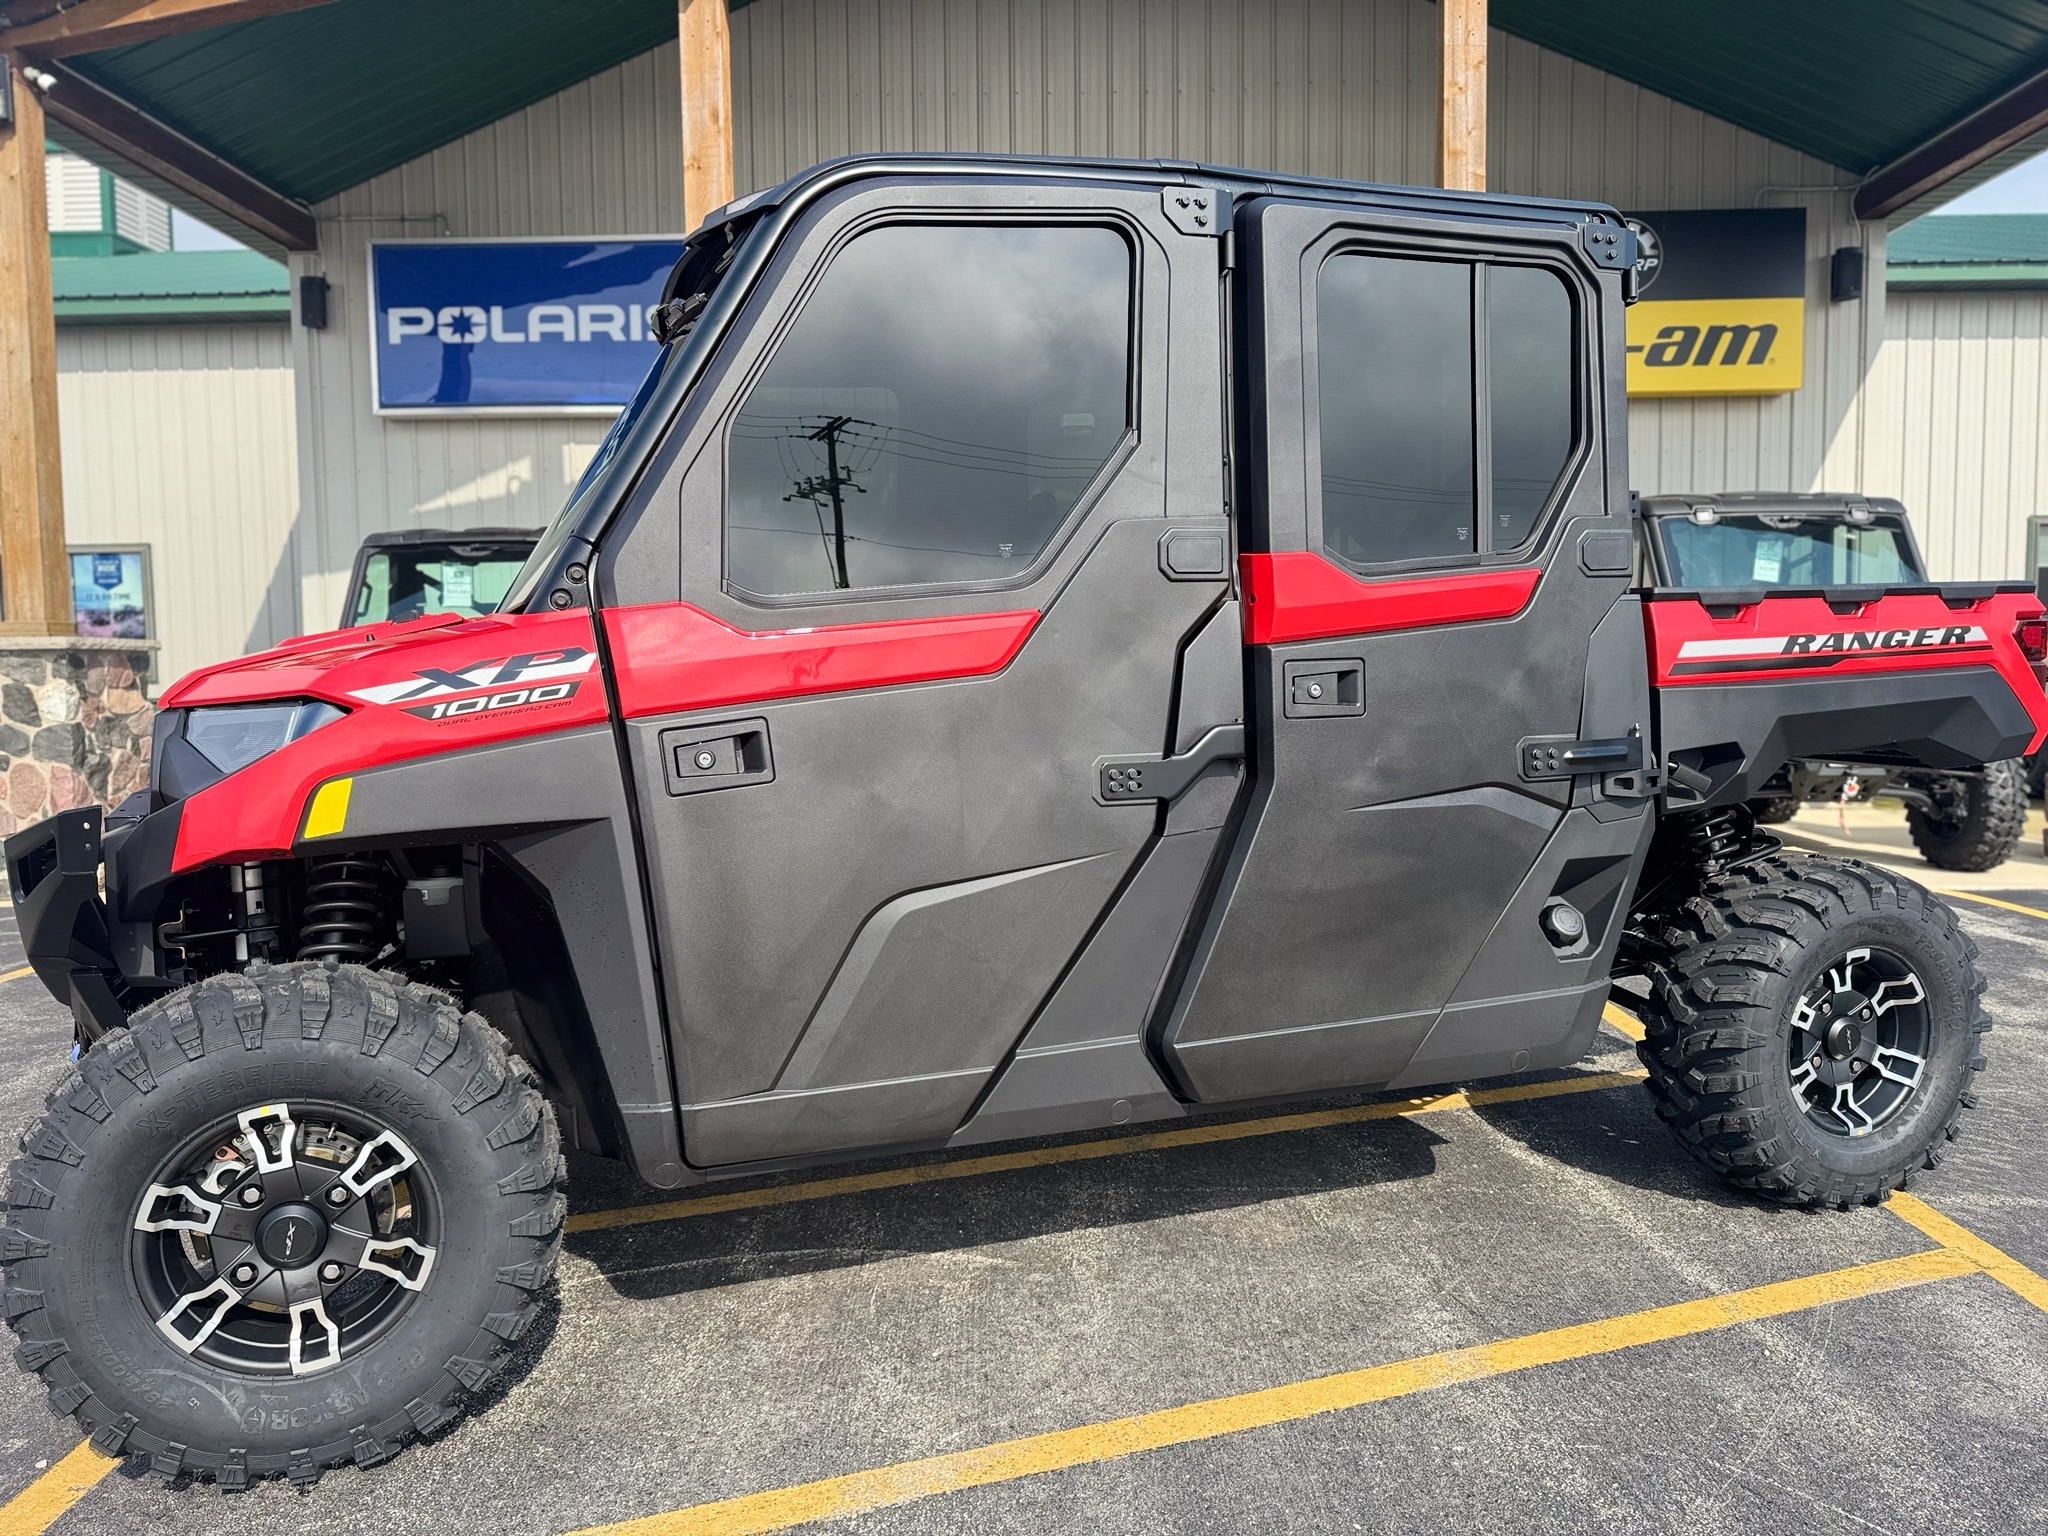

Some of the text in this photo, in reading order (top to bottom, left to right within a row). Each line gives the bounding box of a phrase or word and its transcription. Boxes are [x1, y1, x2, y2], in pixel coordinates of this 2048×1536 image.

[1636, 258, 1659, 271] RP
[1780, 625, 1972, 655] RANGER
[387, 647, 590, 702] XP
[431, 683, 570, 719] 1000
[437, 700, 572, 728] DUAL OVERHEAD CAM
[136, 1061, 329, 1138] X-TERRAIN
